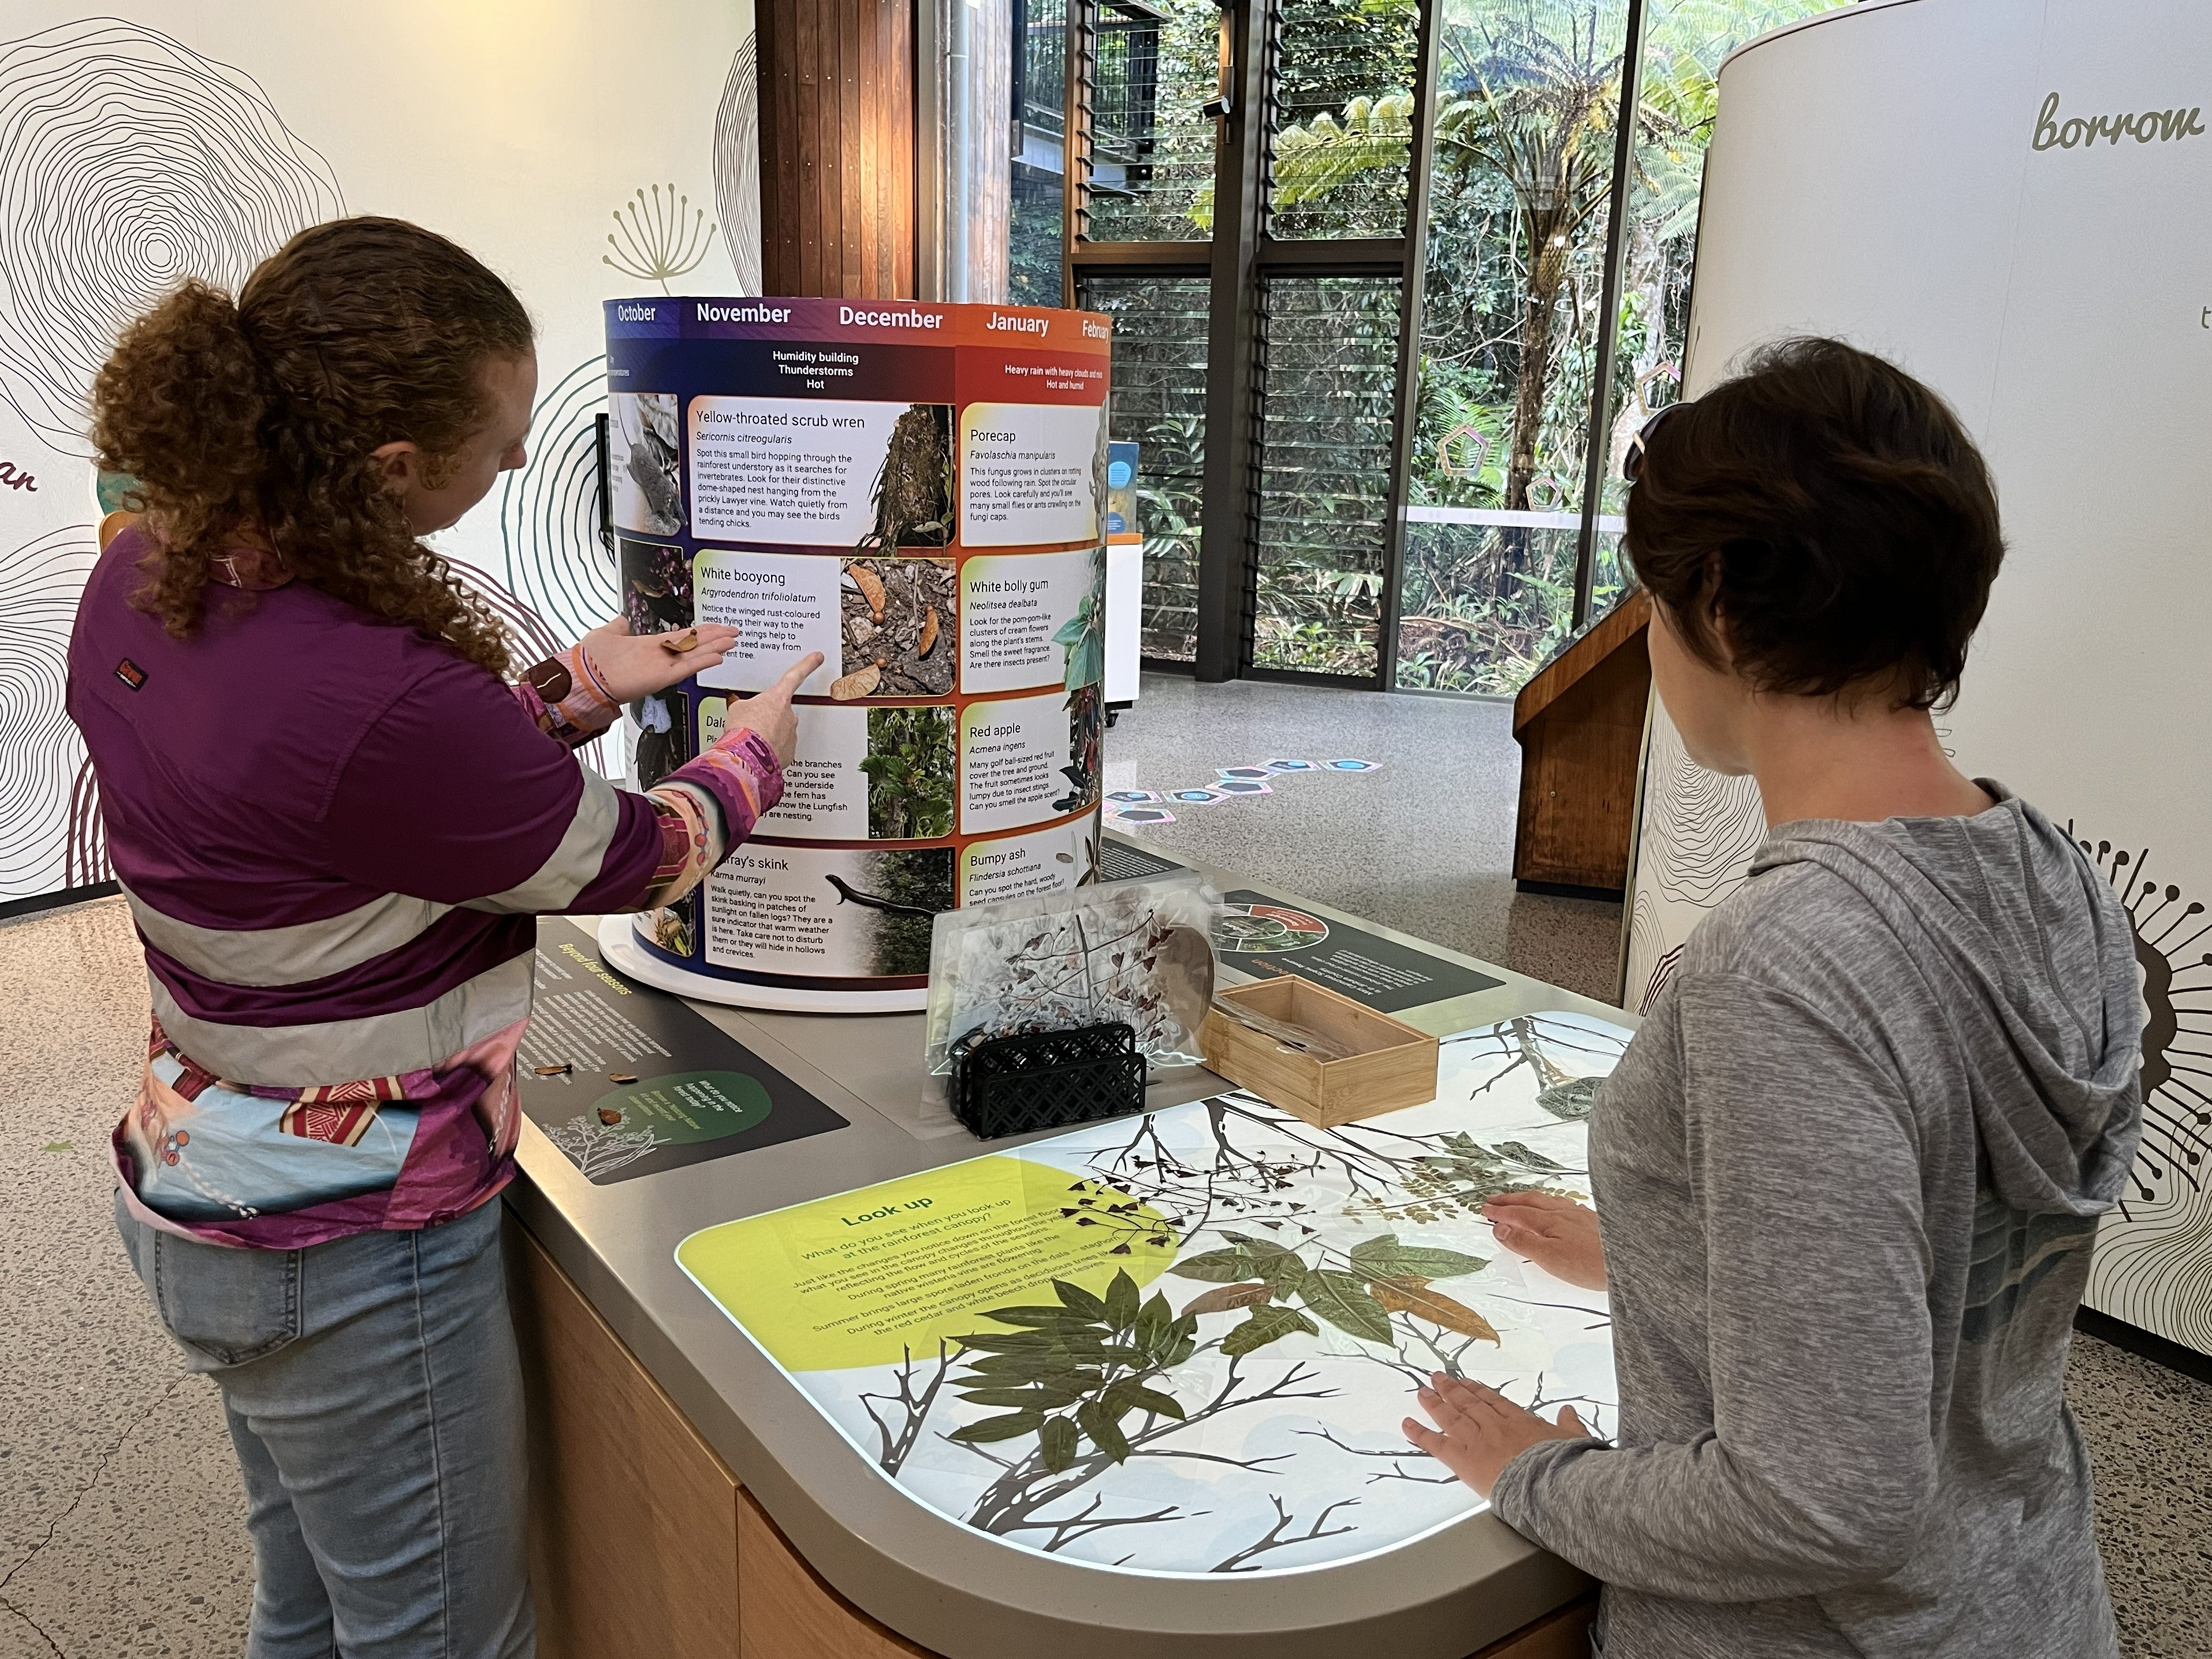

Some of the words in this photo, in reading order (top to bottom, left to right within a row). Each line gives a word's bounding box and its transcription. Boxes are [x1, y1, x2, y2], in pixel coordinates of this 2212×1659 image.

[2032, 92, 2205, 151] borrow
[618, 303, 656, 322] October
[697, 303, 791, 322] November
[840, 306, 943, 329] December
[986, 312, 1049, 337] January
[1082, 319, 1109, 344] February
[773, 351, 817, 364] Humidity
[819, 352, 859, 365] building
[779, 364, 853, 376] Thunderstorms
[1005, 364, 1029, 377] Heavy
[1030, 366, 1043, 375] rain
[1045, 366, 1057, 375] with
[1058, 367, 1074, 379] heavy
[807, 379, 824, 389] Hot
[1047, 380, 1057, 389] Hot
[1059, 381, 1068, 389] and
[1069, 380, 1084, 390] humid
[697, 410, 787, 425] Yellow-throated
[792, 414, 828, 427] scrub
[832, 418, 864, 428] wren
[697, 432, 735, 441] Sericornis
[738, 434, 792, 445] citreogularis
[971, 429, 1015, 444] Porecap
[697, 449, 712, 458] Spot
[714, 449, 727, 457] this
[729, 451, 749, 459] small
[751, 451, 766, 460] bird
[769, 452, 801, 463] hopping
[803, 453, 836, 464] through
[839, 454, 852, 463] the
[970, 451, 1016, 459] Favolaschia
[1018, 451, 1055, 462] manipularis
[697, 460, 730, 470] rainforest
[732, 462, 773, 473] understory
[795, 465, 832, 474] searches
[835, 466, 847, 474] for
[747, 474, 766, 483] Look
[769, 475, 780, 483] for
[782, 476, 800, 484] their
[803, 477, 846, 486] distinctive
[698, 483, 746, 494] dome-shaped
[766, 486, 799, 497] hanging
[801, 488, 821, 496] from
[824, 489, 836, 497] the
[701, 567, 731, 580] White
[734, 569, 785, 586] booyong
[970, 581, 1001, 593] White
[1005, 579, 1027, 593] bolly
[1030, 581, 1048, 593] gum
[701, 587, 759, 599] Argyrodendron
[762, 592, 815, 602] trifoliolatum
[702, 604, 724, 612] Notice
[725, 605, 736, 613] the
[739, 608, 765, 616] winged
[768, 610, 820, 619] rust-coloured
[970, 601, 1007, 610] Neolitsea
[1008, 599, 1037, 608] dealbata
[724, 616, 743, 626] flying
[745, 618, 761, 626] their
[791, 621, 803, 629] the
[970, 618, 987, 626] Look
[1012, 613, 1051, 625] pom-pom-like
[999, 627, 1006, 635] of
[1029, 624, 1048, 633] flowers
[970, 639, 989, 648] along
[1004, 637, 1023, 646] plant's
[970, 650, 989, 658] Smell
[1004, 648, 1022, 656] sweet
[1027, 654, 1050, 665] present?
[970, 725, 990, 738] Red
[994, 723, 1020, 738] apple
[969, 745, 1001, 754] Acmena
[1003, 742, 1025, 752] ingens
[1016, 765, 1027, 773] and
[1000, 776, 1033, 787] sometimes
[1034, 772, 1049, 780] looks
[725, 856, 754, 868] rray's
[758, 857, 788, 871] skink
[971, 854, 1006, 866] Bumpy
[1009, 847, 1025, 860] ash
[736, 875, 766, 886] murrayi
[969, 871, 1005, 882] Flindersia
[1007, 864, 1041, 876] schottiana
[711, 884, 726, 894] Walk
[728, 889, 751, 899] quietly,
[803, 895, 815, 903] the
[712, 895, 728, 904] skink
[729, 898, 756, 908] basking
[712, 906, 737, 916] sunlight
[750, 910, 769, 919] fallen
[792, 915, 811, 923] They
[558, 943, 594, 962] Beyond
[582, 961, 604, 973] four
[597, 973, 632, 995] seasons
[841, 1206, 902, 1226] Look
[903, 1198, 933, 1209] up
[802, 1247, 838, 1259] What
[858, 1235, 883, 1246] you
[885, 1229, 907, 1237] see
[909, 1219, 943, 1230] when
[943, 1212, 967, 1222] you
[966, 1204, 995, 1214] look
[858, 1246, 880, 1254] the
[881, 1228, 942, 1248] rainforest
[943, 1213, 991, 1230] canopy?
